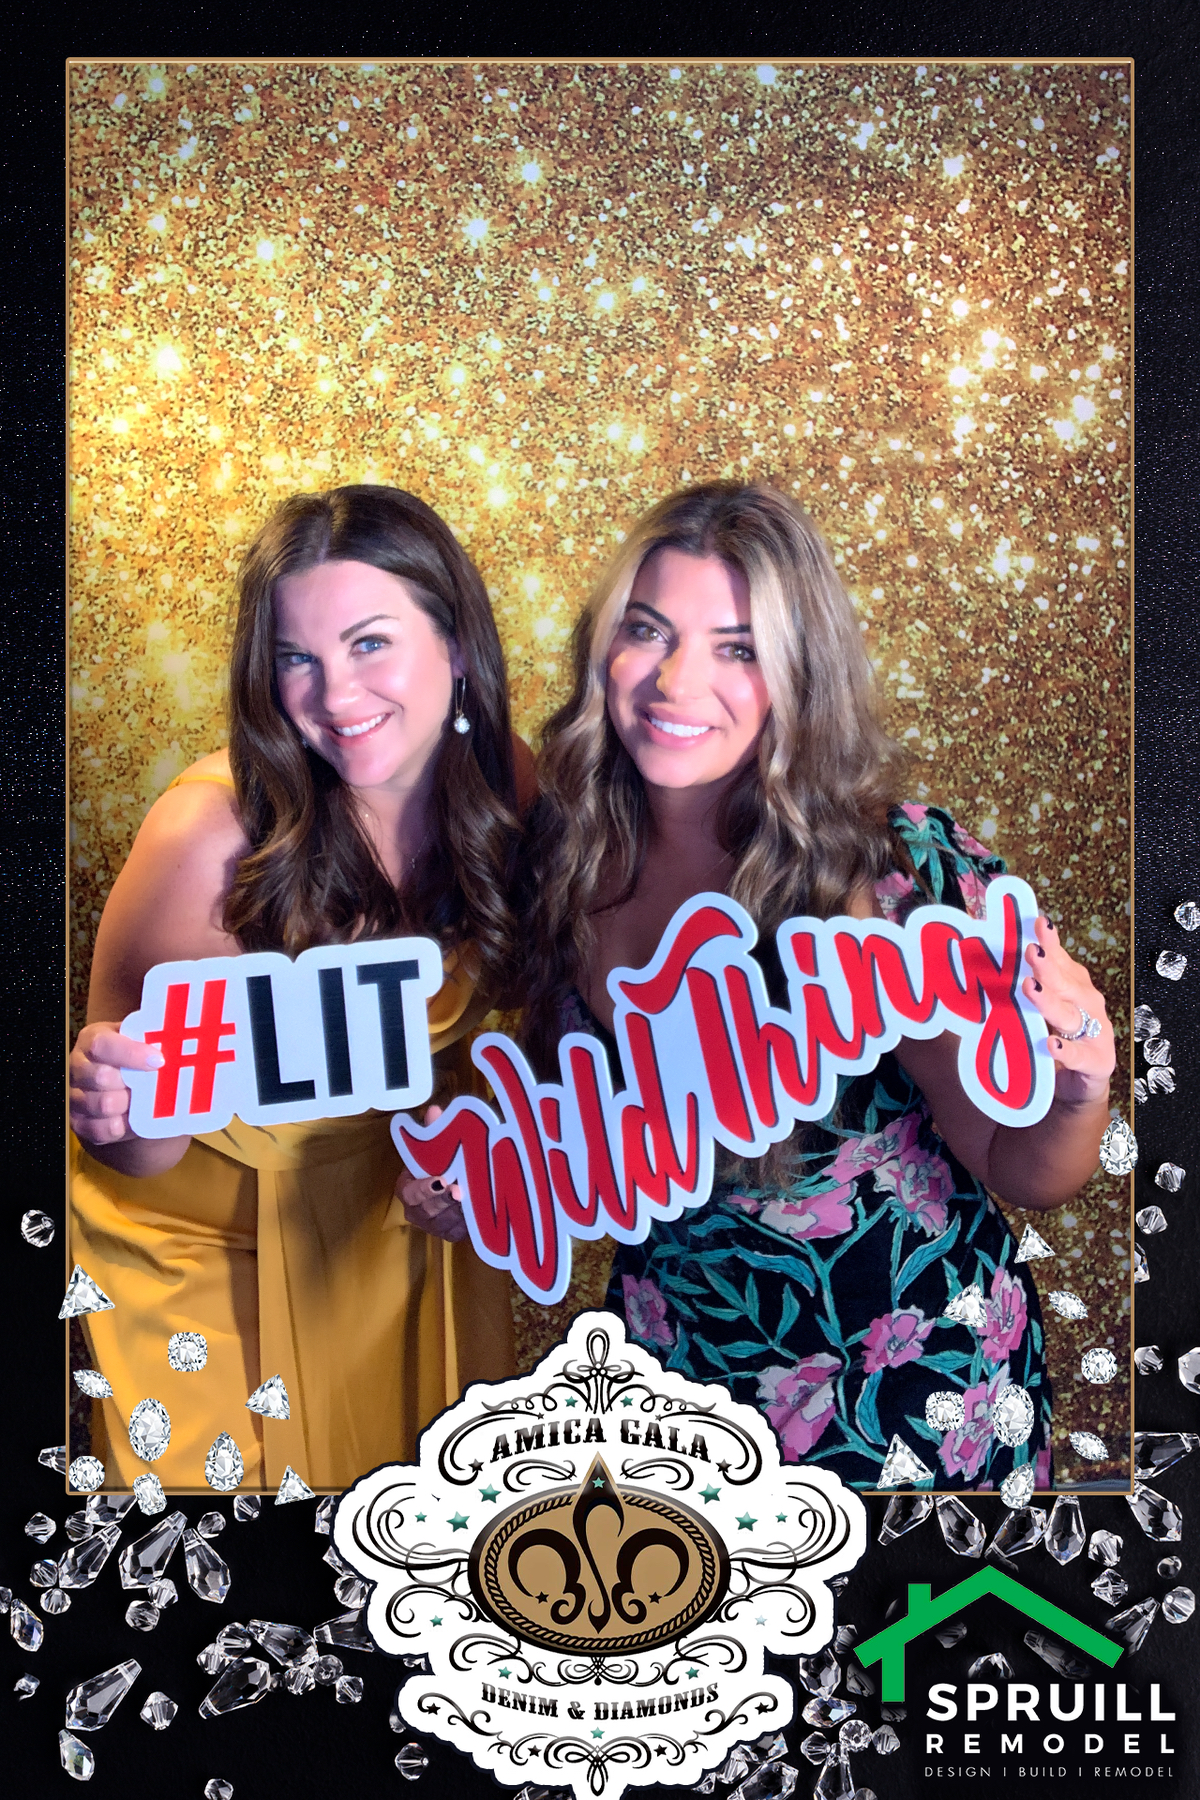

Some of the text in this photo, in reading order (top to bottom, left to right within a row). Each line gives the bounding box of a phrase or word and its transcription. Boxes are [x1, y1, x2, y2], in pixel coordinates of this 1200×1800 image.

[144, 958, 420, 1119] #LIT
[399, 893, 1037, 1291] Wild Thing
